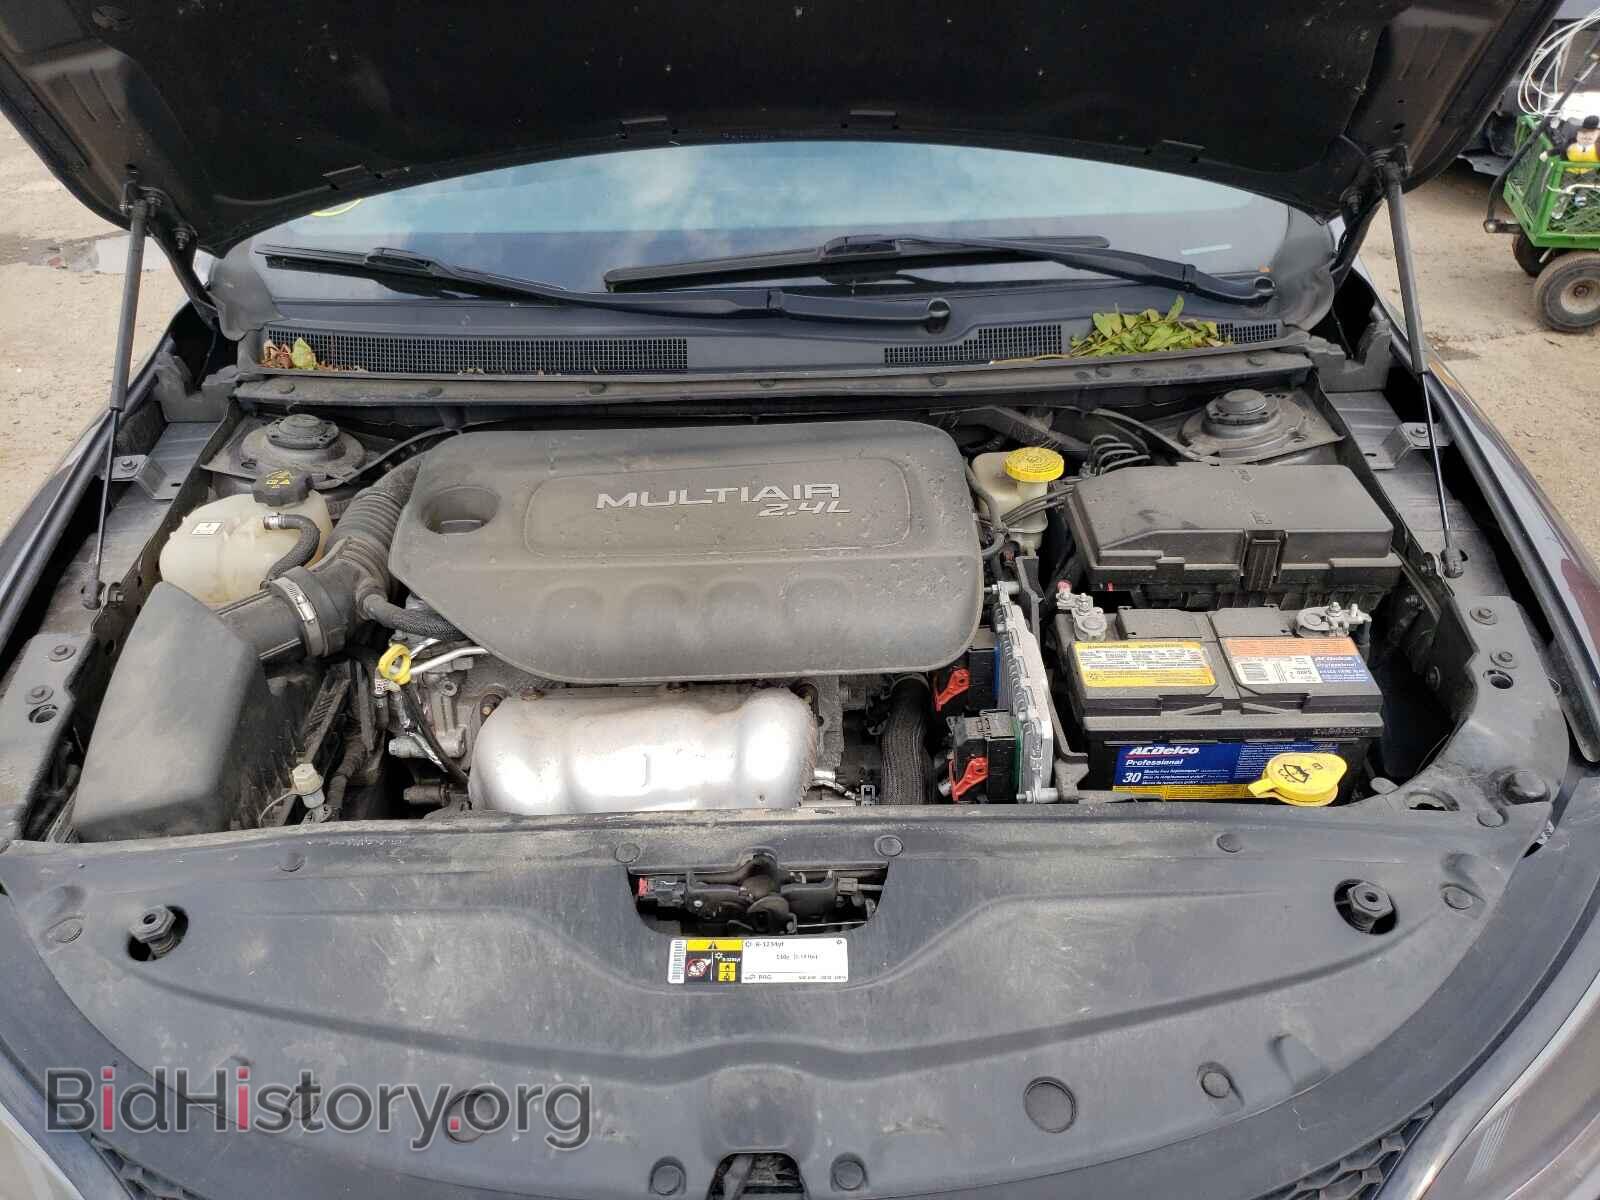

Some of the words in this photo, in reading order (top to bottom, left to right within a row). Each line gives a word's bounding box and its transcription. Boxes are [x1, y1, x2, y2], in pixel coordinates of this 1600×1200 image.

[595, 483, 840, 509] MULTIAIR
[758, 500, 851, 517] 2.4L
[1127, 745, 1200, 755] ACDelco
[1125, 758, 1184, 766] Professional
[1122, 772, 1142, 783] 30
